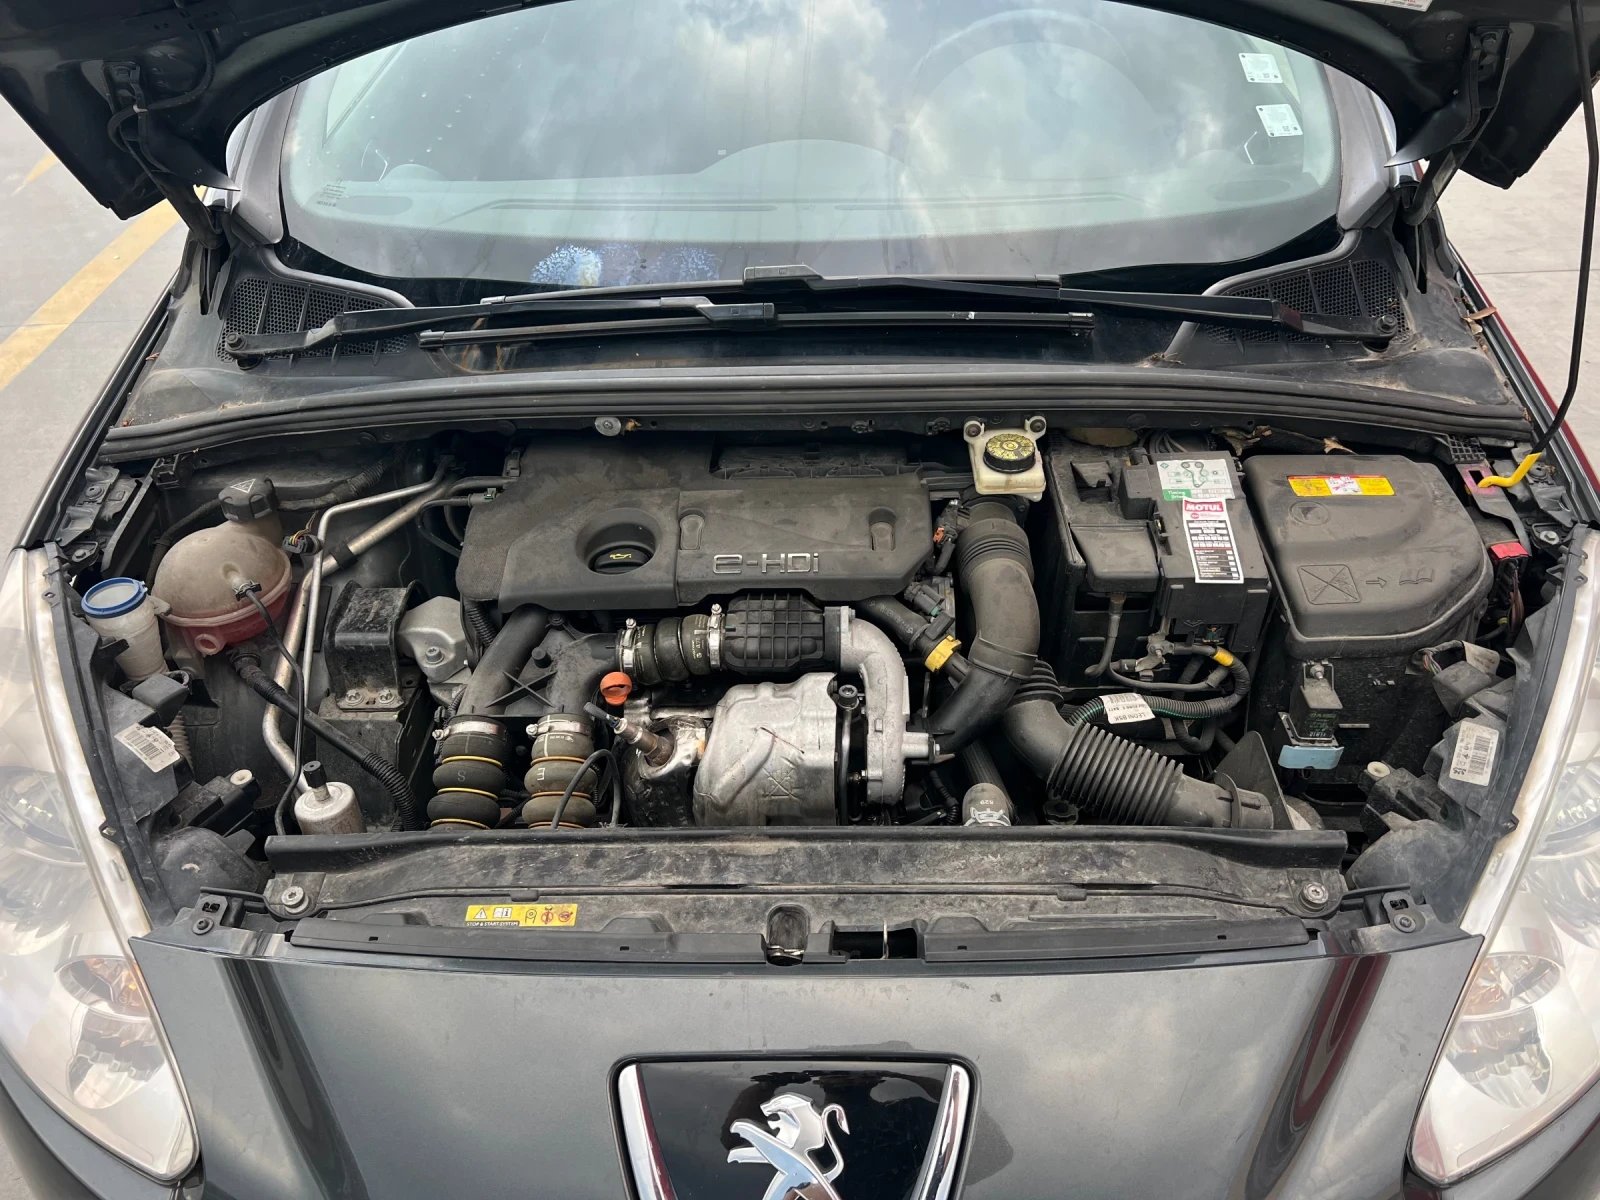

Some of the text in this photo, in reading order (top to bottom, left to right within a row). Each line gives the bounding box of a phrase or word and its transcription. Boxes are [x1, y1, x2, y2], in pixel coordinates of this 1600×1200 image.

[1186, 503, 1222, 511] MOTUL
[713, 553, 819, 574] e-HDi
[457, 771, 466, 782] S
